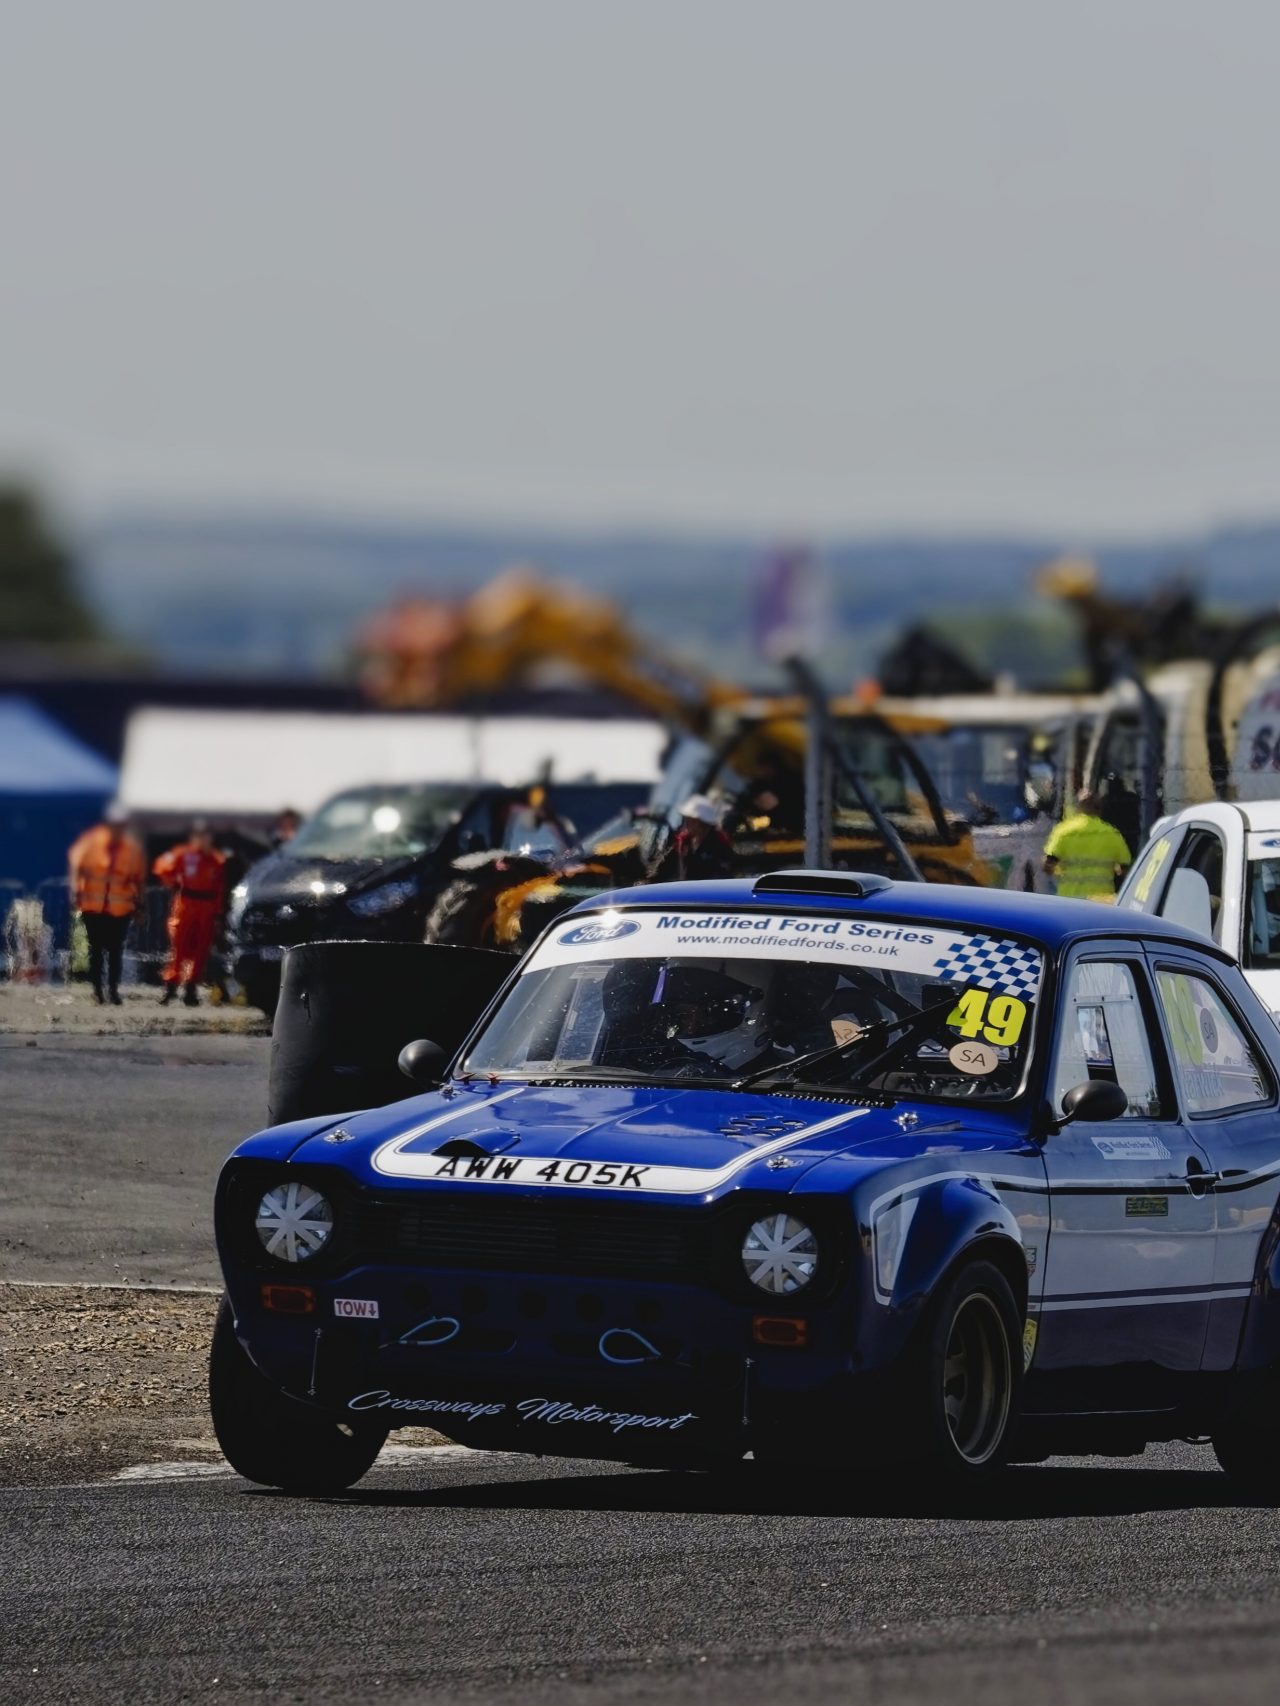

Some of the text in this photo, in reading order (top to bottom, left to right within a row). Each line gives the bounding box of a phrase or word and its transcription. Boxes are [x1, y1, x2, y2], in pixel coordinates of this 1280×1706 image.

[571, 921, 625, 943] Ford
[656, 916, 935, 946] Modified Ford Series
[677, 934, 901, 957] www.modifiedfords.co.uk
[946, 988, 1027, 1047] 49
[959, 1049, 987, 1068] SA
[434, 1156, 651, 1187] AWW 405K
[335, 1300, 367, 1316] TOW
[348, 1389, 700, 1434] Crossways Motorsport
